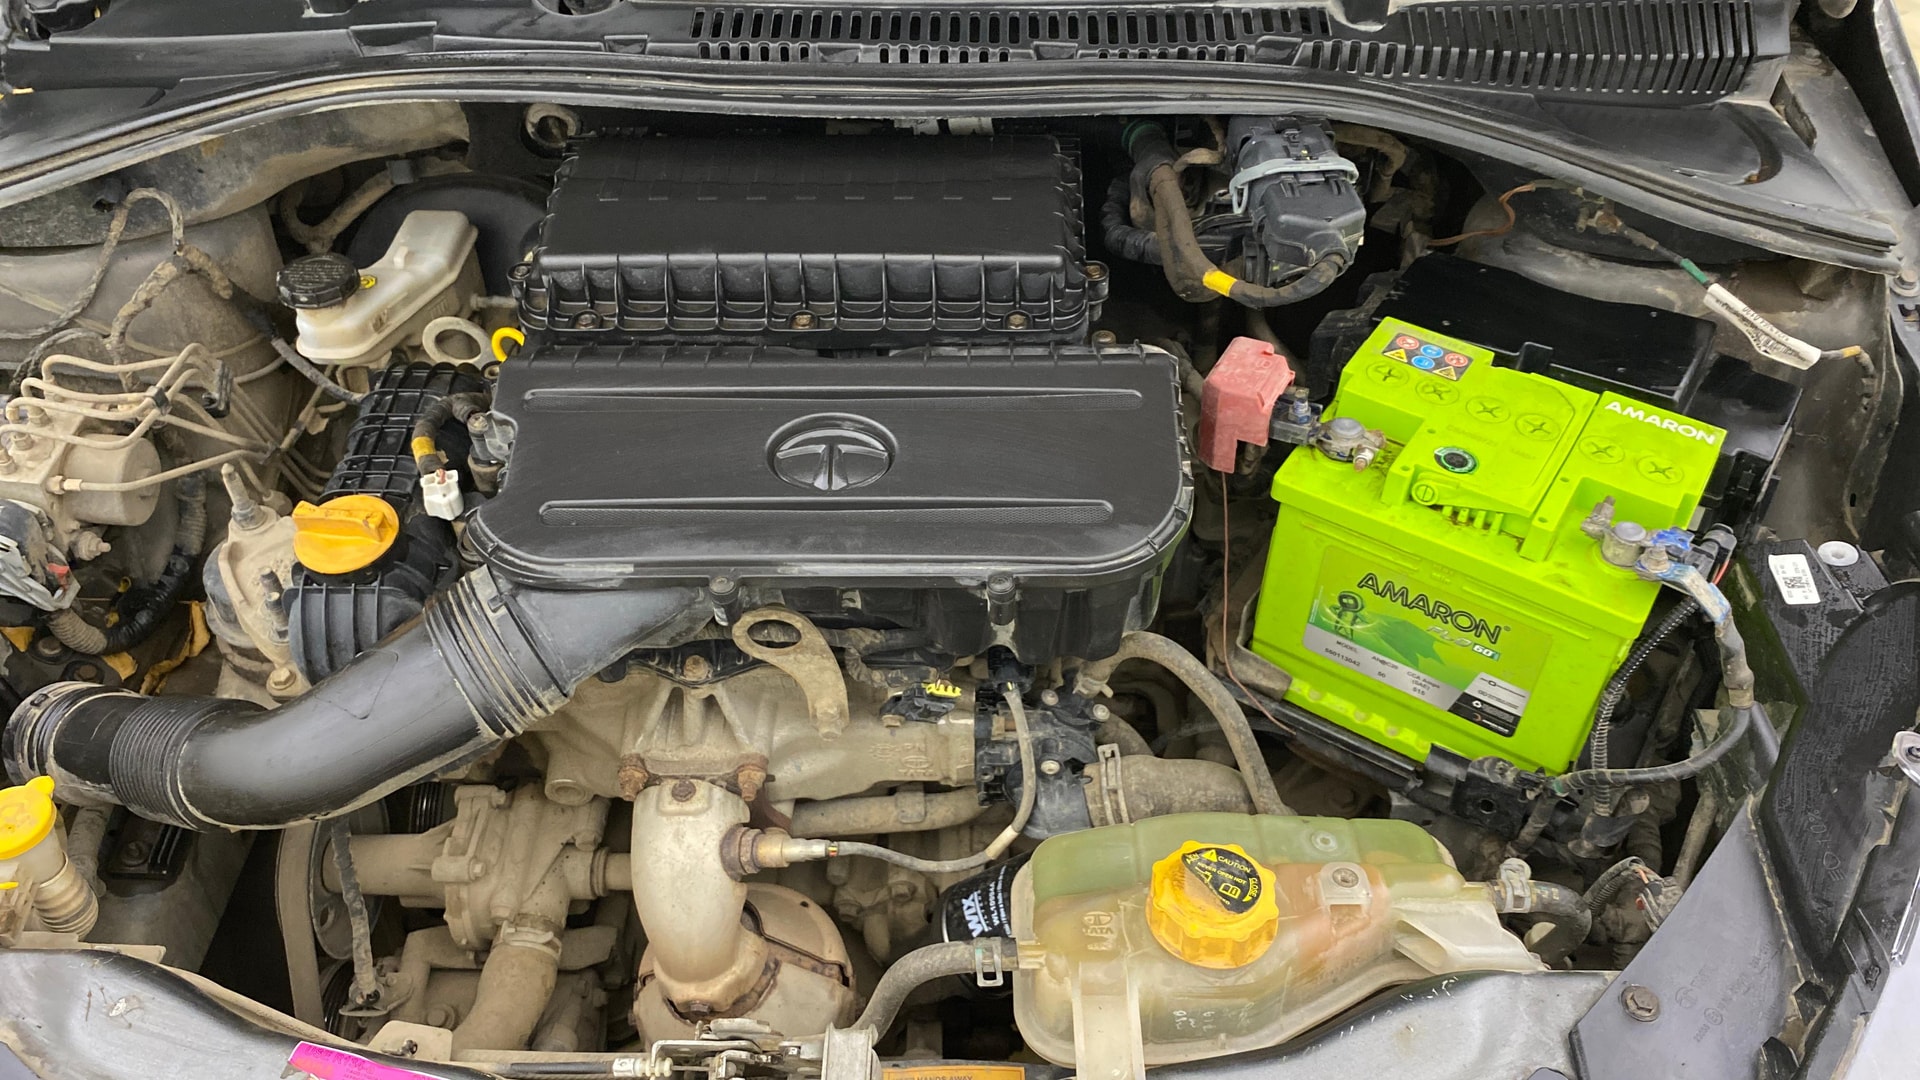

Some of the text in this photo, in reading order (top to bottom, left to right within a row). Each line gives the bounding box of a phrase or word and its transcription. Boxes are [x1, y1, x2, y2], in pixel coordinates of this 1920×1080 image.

[1605, 400, 1716, 446] AMARON
[1357, 572, 1502, 644] AMARON
[1217, 856, 1251, 874] CAUTION
[1217, 869, 1234, 879] OPEN
[1234, 876, 1247, 885] HOT
[961, 892, 984, 938] WIX
[1082, 926, 1114, 936] TATA
